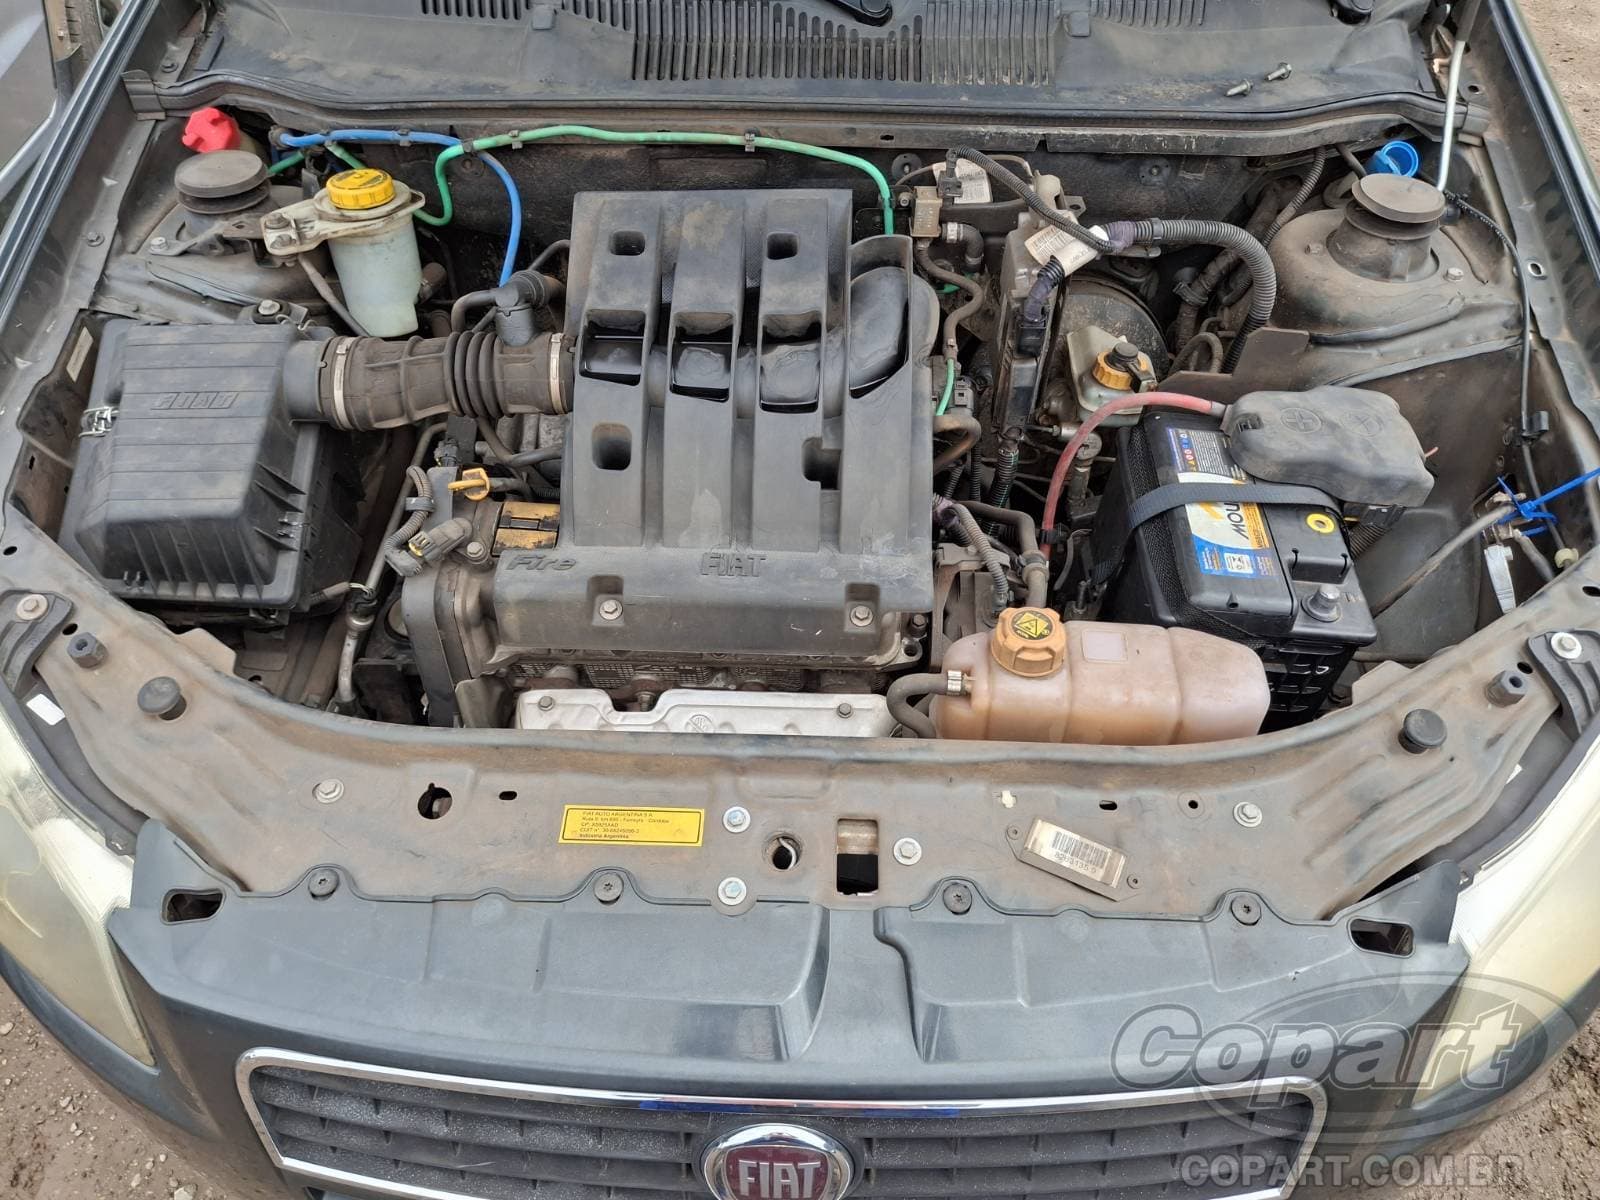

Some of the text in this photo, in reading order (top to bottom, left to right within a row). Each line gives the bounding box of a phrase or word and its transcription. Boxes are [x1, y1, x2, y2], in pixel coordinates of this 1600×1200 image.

[1222, 502, 1250, 540] MOU
[505, 554, 577, 571] Fire
[701, 552, 766, 577] FIAT
[738, 1159, 821, 1199] FIAT
